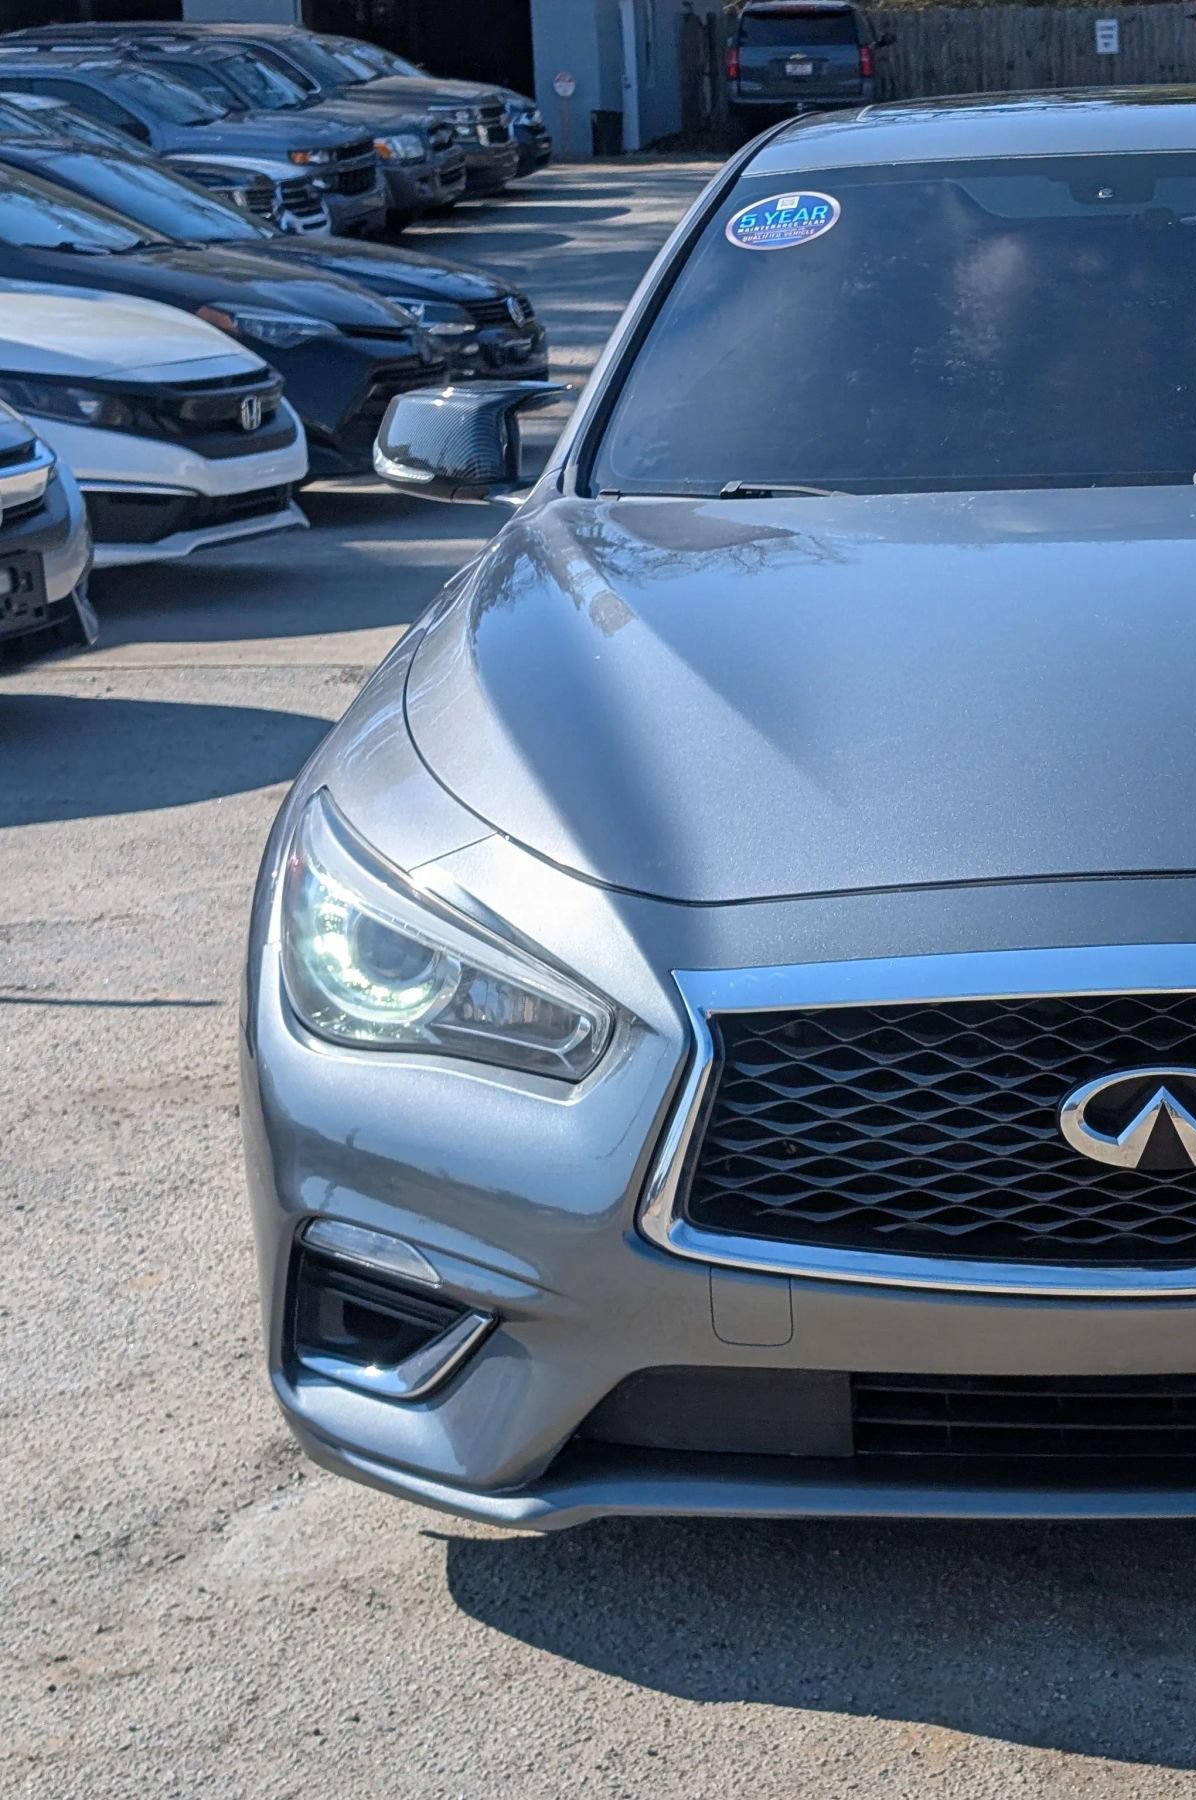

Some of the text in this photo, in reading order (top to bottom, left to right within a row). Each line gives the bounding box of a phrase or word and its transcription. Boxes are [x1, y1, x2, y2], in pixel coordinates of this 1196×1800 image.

[739, 205, 829, 228] 5 YEAR
[737, 222, 799, 233] MAINTENANCE
[784, 228, 816, 237] VEHICLE
